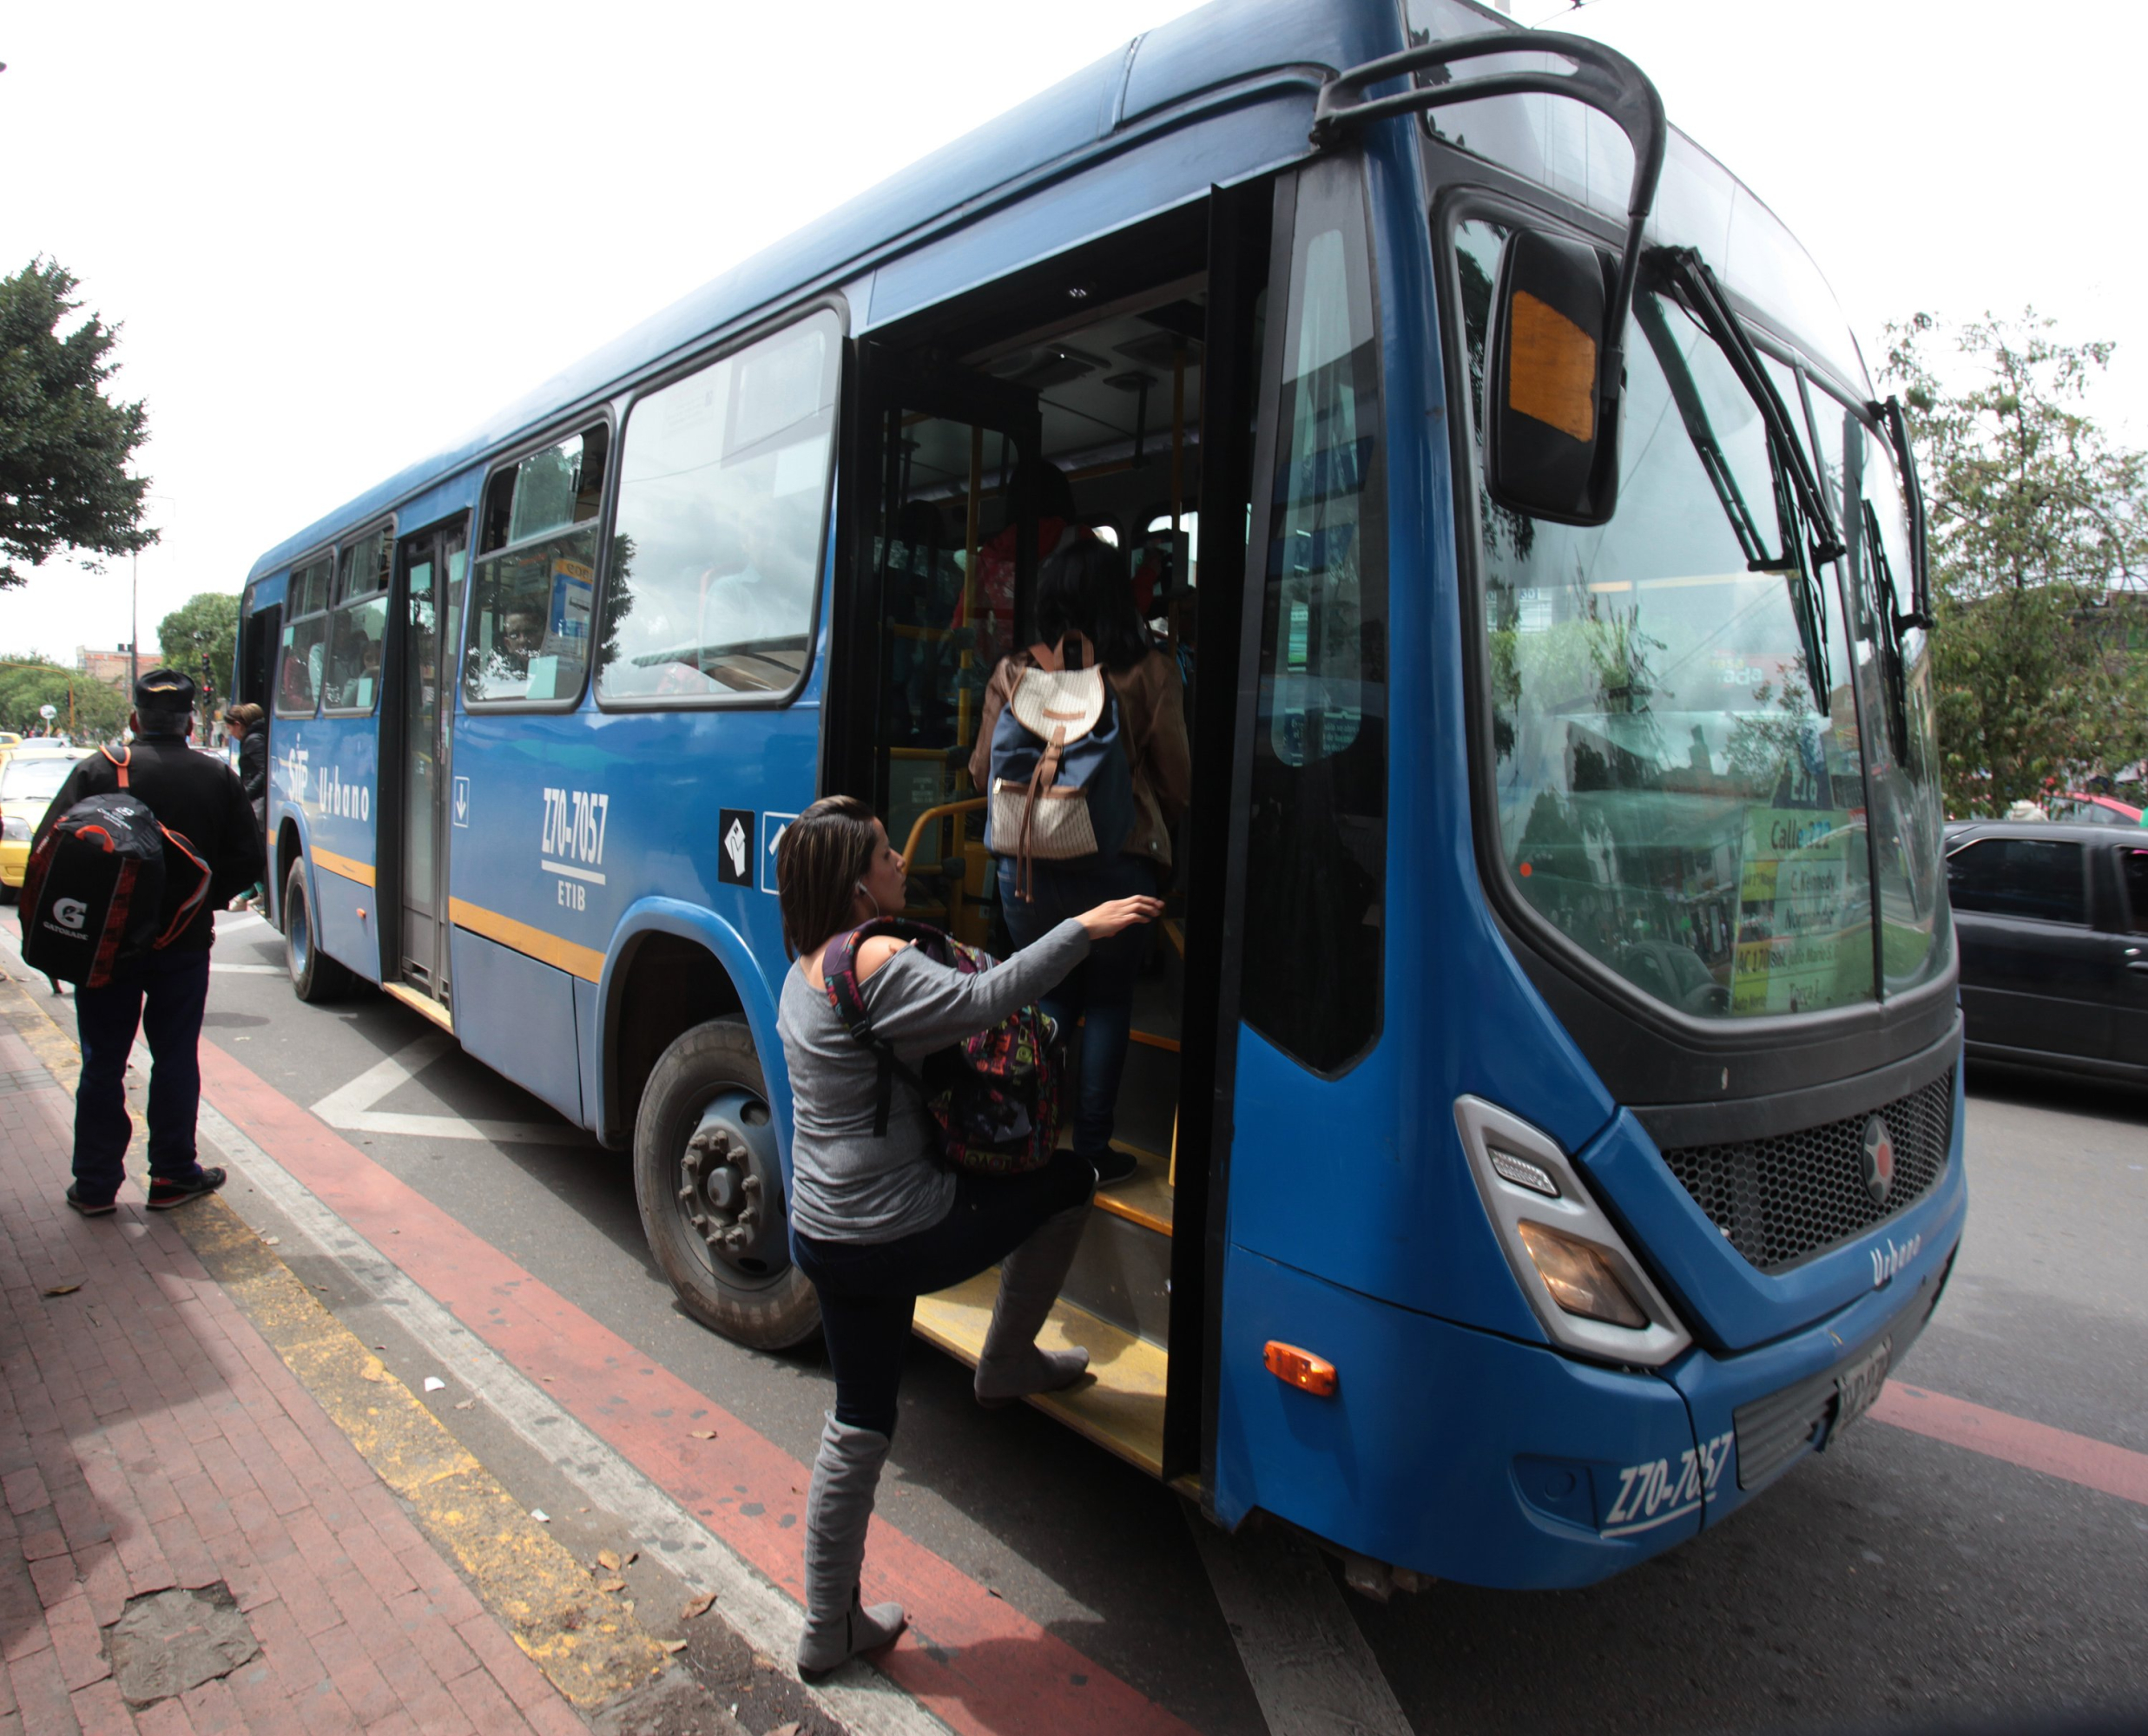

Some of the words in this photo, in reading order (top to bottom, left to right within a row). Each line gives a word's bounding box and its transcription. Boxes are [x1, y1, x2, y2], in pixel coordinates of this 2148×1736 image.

[320, 765, 369, 822] Urbano
[542, 787, 609, 865] Z70-7057
[1771, 819, 1803, 850] Calle
[558, 879, 585, 911] ETIB
[43, 921, 89, 940] GATORADE
[1870, 1233, 1921, 1286] Urbano
[1606, 1430, 1734, 1523] Z70-7057
